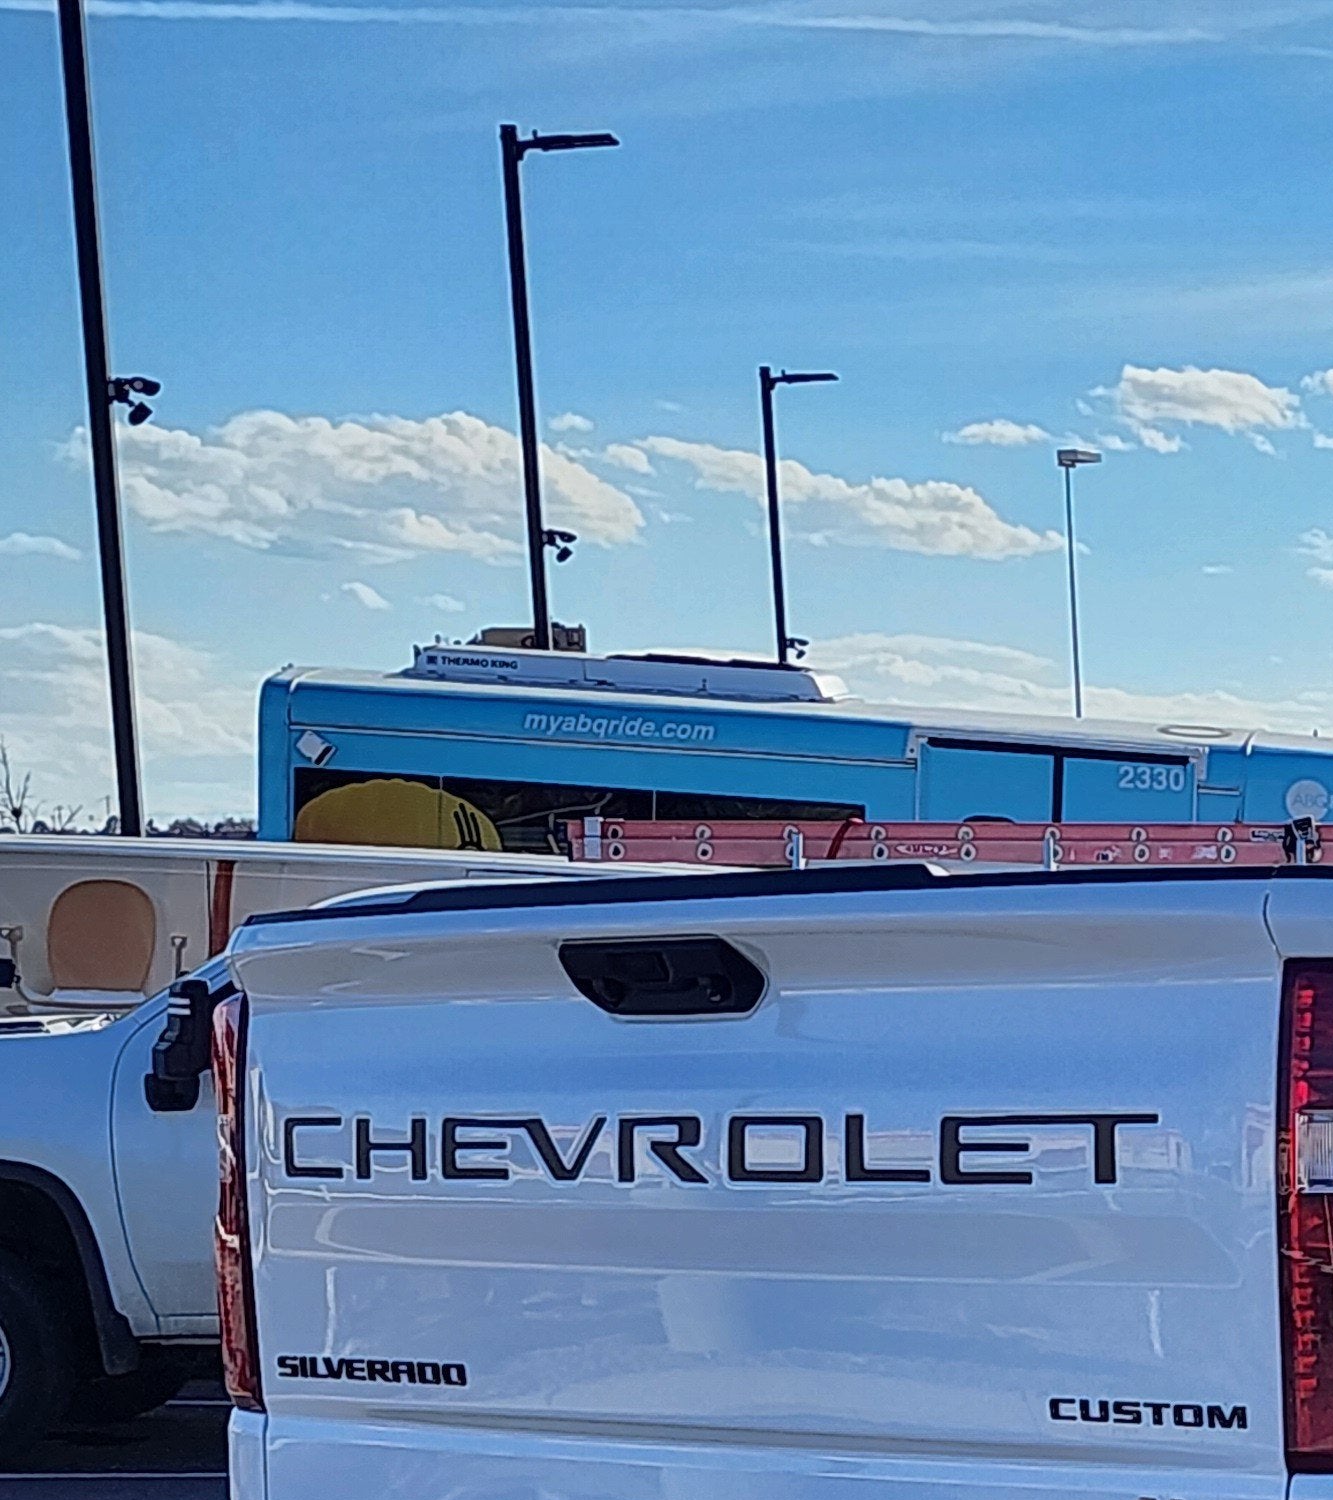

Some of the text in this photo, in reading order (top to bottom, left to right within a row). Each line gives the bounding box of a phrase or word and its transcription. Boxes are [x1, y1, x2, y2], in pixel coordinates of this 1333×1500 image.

[441, 655, 518, 670] THERMO KING
[523, 713, 715, 740] myabqride.com
[1118, 765, 1185, 791] 2330
[283, 1113, 1160, 1187] CHEVROLET
[277, 1355, 468, 1387] SILVERADO
[1048, 1397, 1249, 1430] CUSTOM
